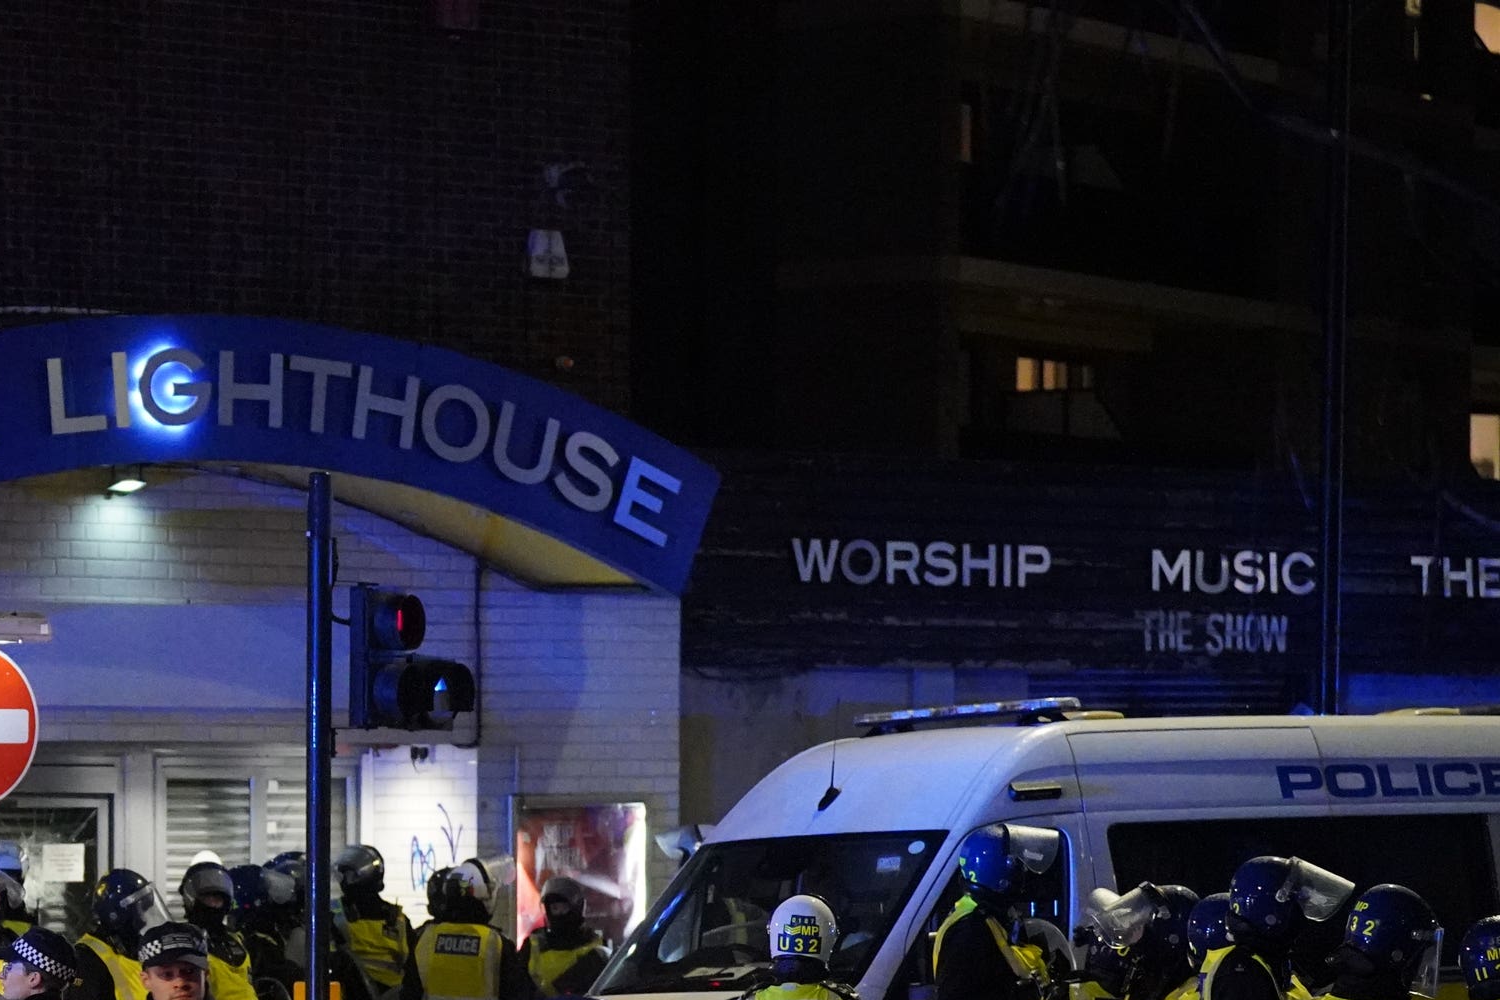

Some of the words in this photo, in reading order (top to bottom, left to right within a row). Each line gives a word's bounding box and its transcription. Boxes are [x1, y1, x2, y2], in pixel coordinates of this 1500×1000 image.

[47, 347, 683, 548] LIGHTHOUSE
[791, 537, 1051, 588] WORSHIP
[1150, 549, 1316, 596] MUSIC
[1135, 610, 1194, 652] THE
[1206, 613, 1288, 656] SHOW
[437, 936, 479, 954] POLICE
[801, 925, 819, 936] MP
